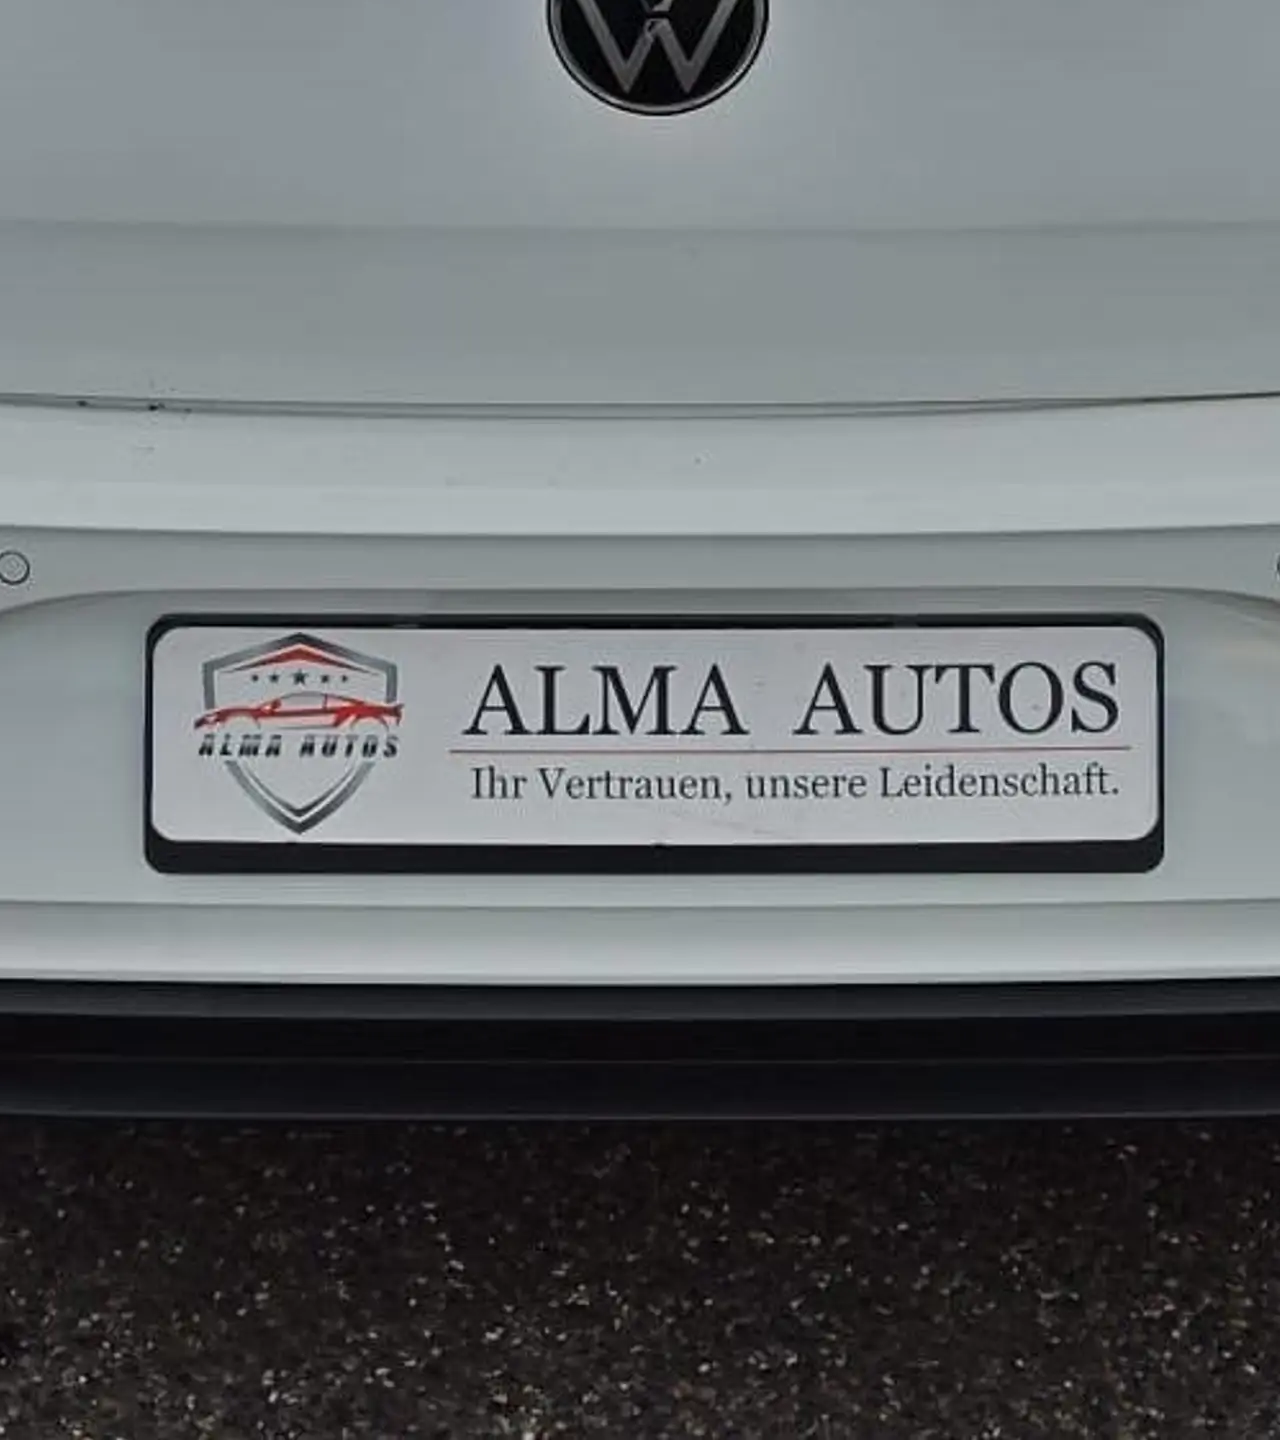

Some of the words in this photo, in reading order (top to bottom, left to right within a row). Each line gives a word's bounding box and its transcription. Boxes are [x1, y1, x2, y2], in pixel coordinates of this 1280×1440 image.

[462, 663, 750, 737] ALMA
[793, 661, 1119, 736] AUTOS
[198, 734, 282, 757] ALMA
[299, 734, 400, 758] AUTOS
[471, 766, 527, 799] Ihr
[539, 768, 733, 807] Vertrauen,
[746, 774, 868, 799] unsere
[880, 762, 1120, 798] Leidenschaft.
